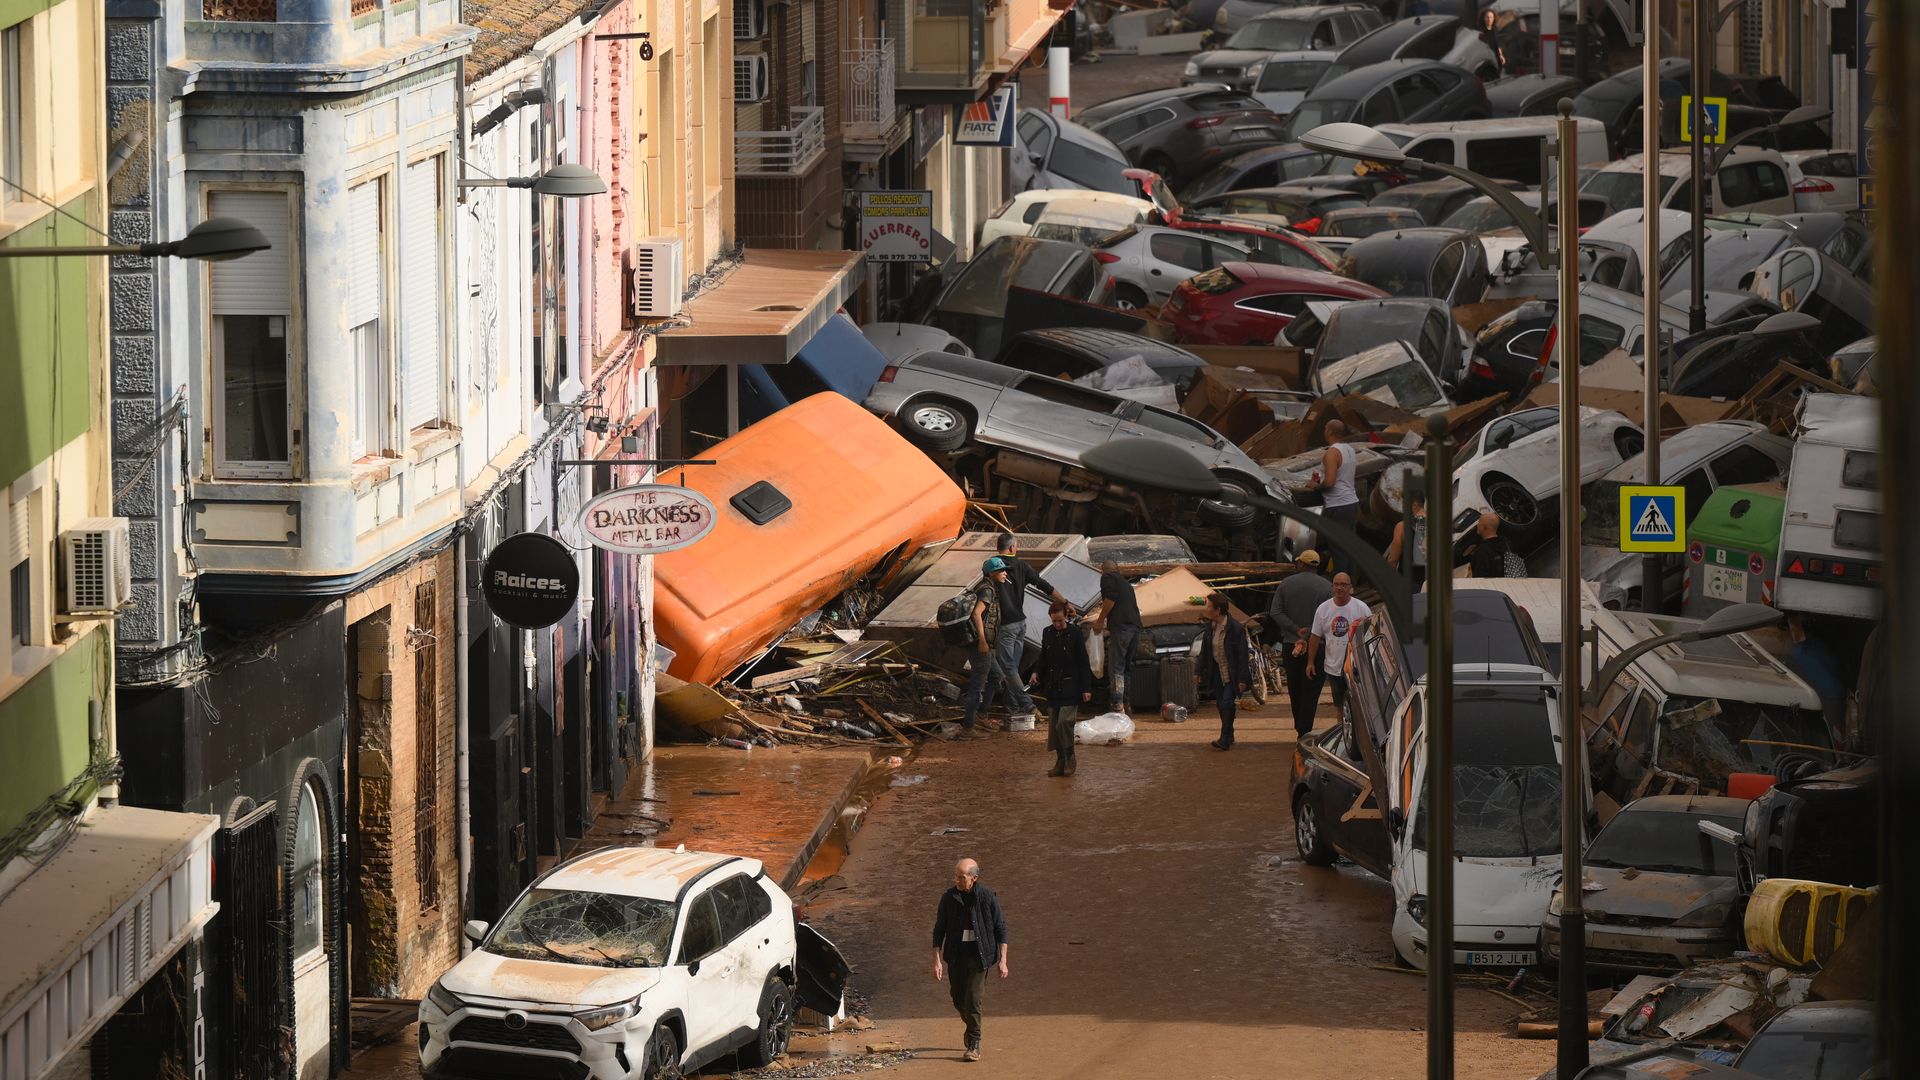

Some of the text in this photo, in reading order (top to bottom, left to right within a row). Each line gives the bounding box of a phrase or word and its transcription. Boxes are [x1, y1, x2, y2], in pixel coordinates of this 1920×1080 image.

[964, 122, 996, 132] FIATC
[870, 194, 892, 204] POLLOS
[890, 207, 906, 217] PARA
[907, 207, 929, 217] LLEVAR
[864, 223, 929, 249] GUERRERO
[634, 492, 657, 505] PUB
[593, 503, 701, 528] DARKNESS
[612, 526, 681, 542] METAL BAR
[494, 570, 561, 591] Raices
[1474, 954, 1503, 964] 8512
